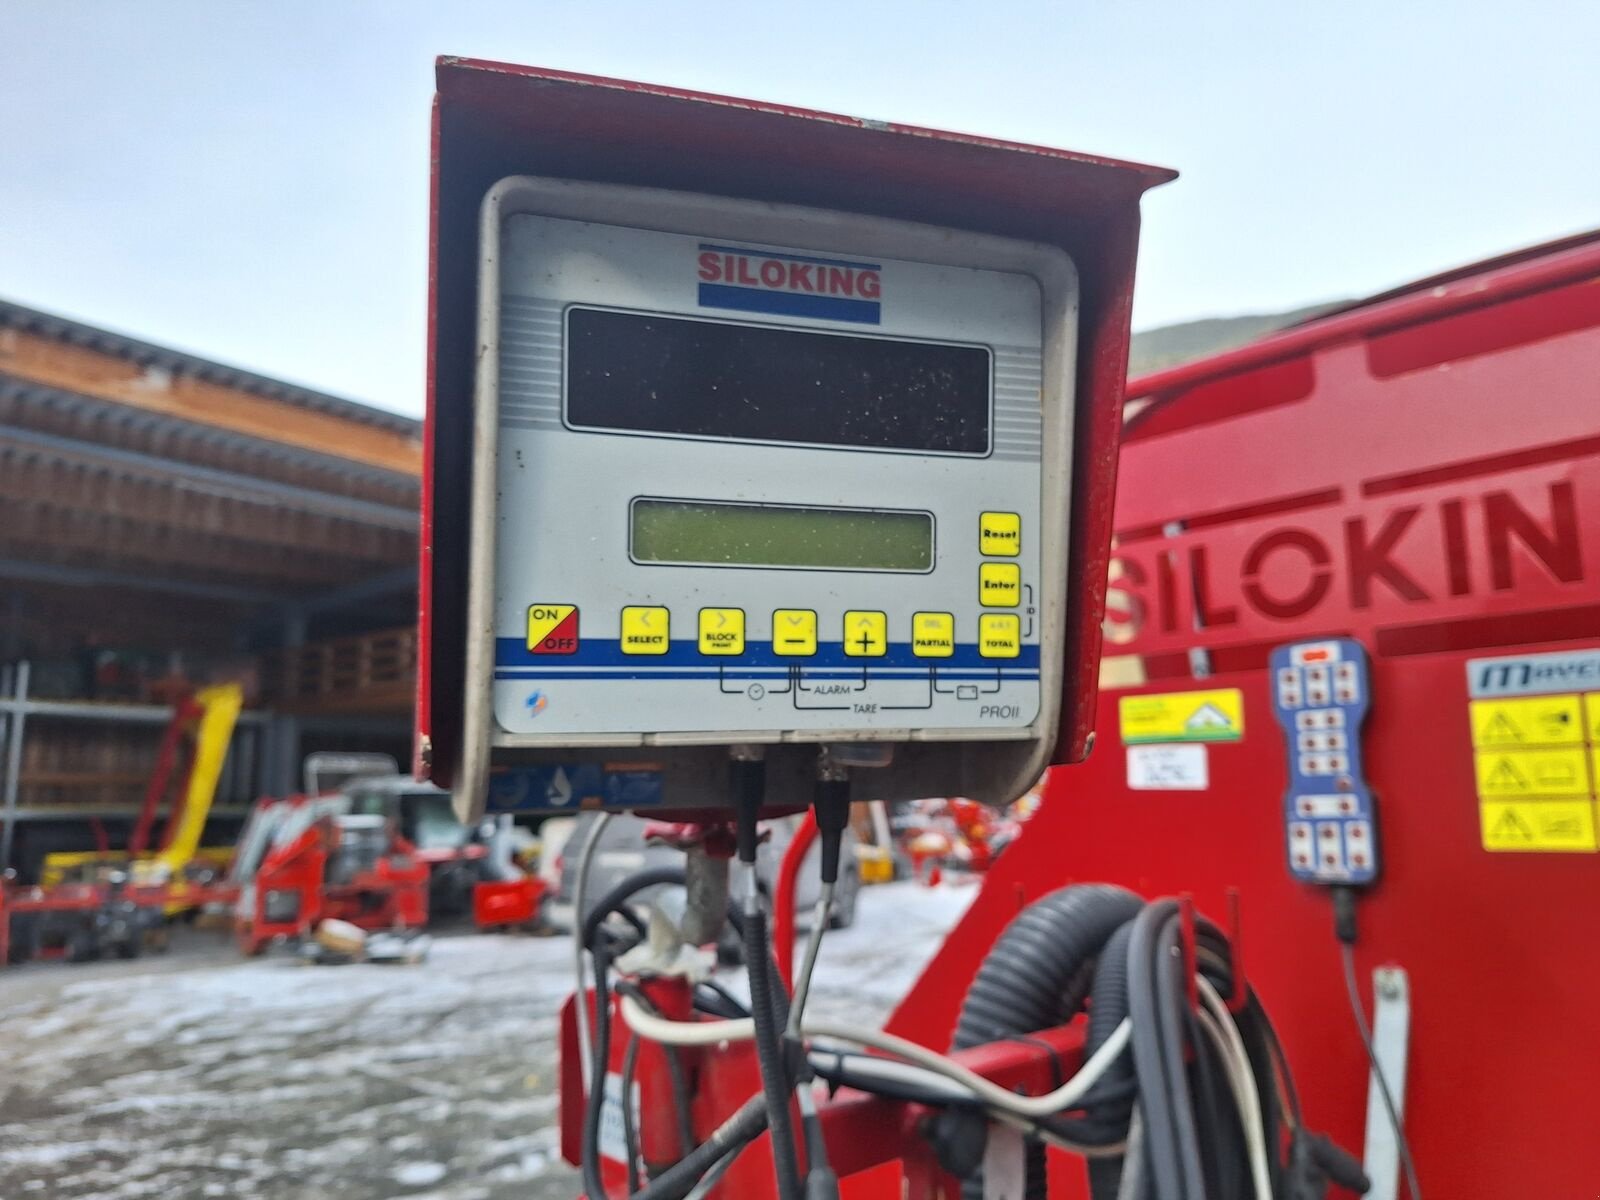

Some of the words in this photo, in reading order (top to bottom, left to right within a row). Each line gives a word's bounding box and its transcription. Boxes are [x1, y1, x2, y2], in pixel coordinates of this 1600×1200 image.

[698, 252, 881, 299] SILOKING
[983, 529, 1017, 539] Reset
[984, 580, 1016, 590] Enter
[533, 608, 558, 620] ON
[1026, 606, 1035, 615] ID
[627, 635, 664, 644] SELECT
[706, 633, 737, 641] BLOCK
[544, 638, 575, 650] OFF
[915, 639, 951, 647] PARTIAL
[985, 640, 1014, 648] TOTAL
[813, 684, 851, 695] ALARM
[853, 703, 878, 714] TARE
